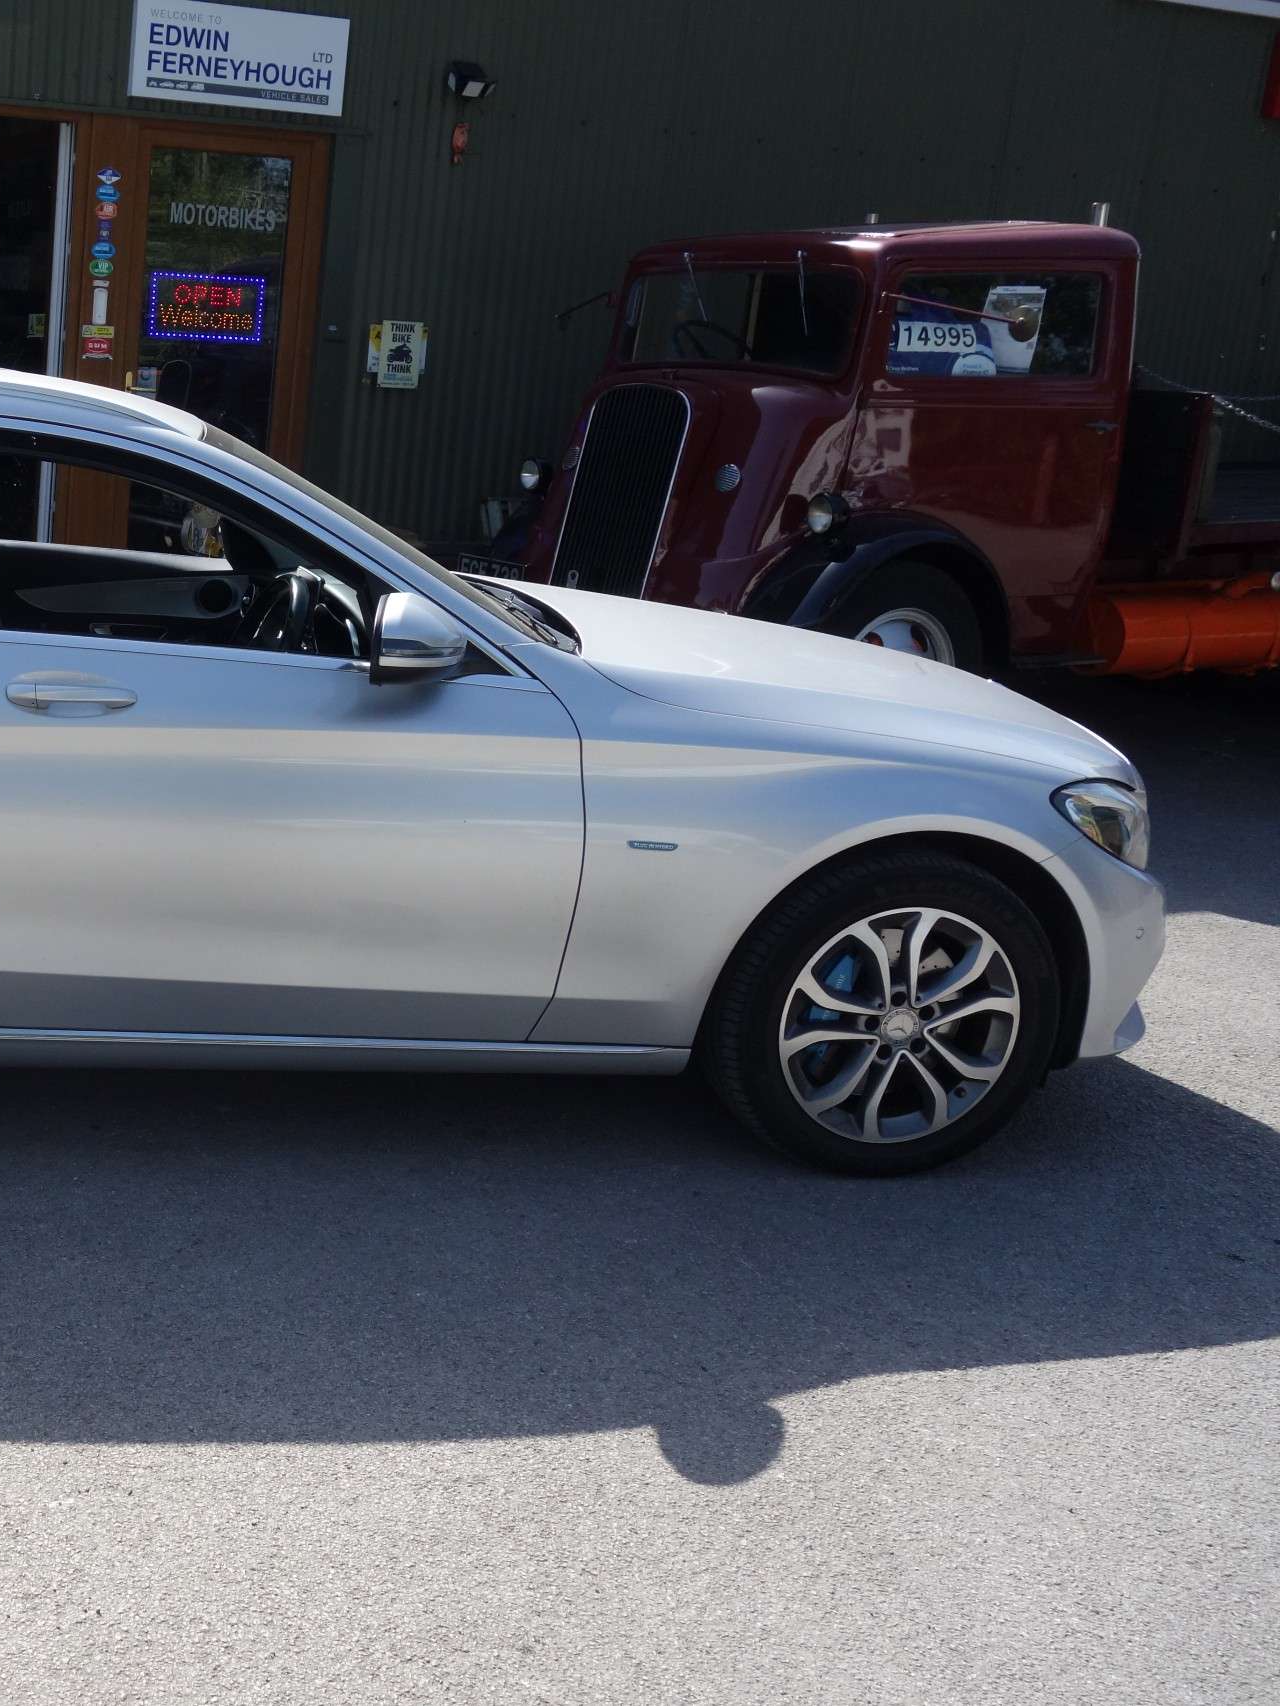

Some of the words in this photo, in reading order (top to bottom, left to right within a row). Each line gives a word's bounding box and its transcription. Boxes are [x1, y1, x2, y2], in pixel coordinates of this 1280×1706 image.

[150, 8, 204, 23] WELCOME
[208, 15, 223, 25] TO
[149, 22, 230, 52] EDWIN
[312, 51, 333, 64] LTD
[147, 51, 332, 90] FERNEYHOUGH
[260, 90, 297, 102] VEHICLE
[299, 94, 328, 105] SALES
[170, 202, 276, 232] MOTORBIKES
[175, 284, 242, 307] OPEN
[159, 303, 253, 330] Welcome
[391, 323, 416, 333] THINK
[903, 326, 975, 348] 14995
[392, 333, 412, 344] BIKE
[386, 363, 412, 374] THINK
